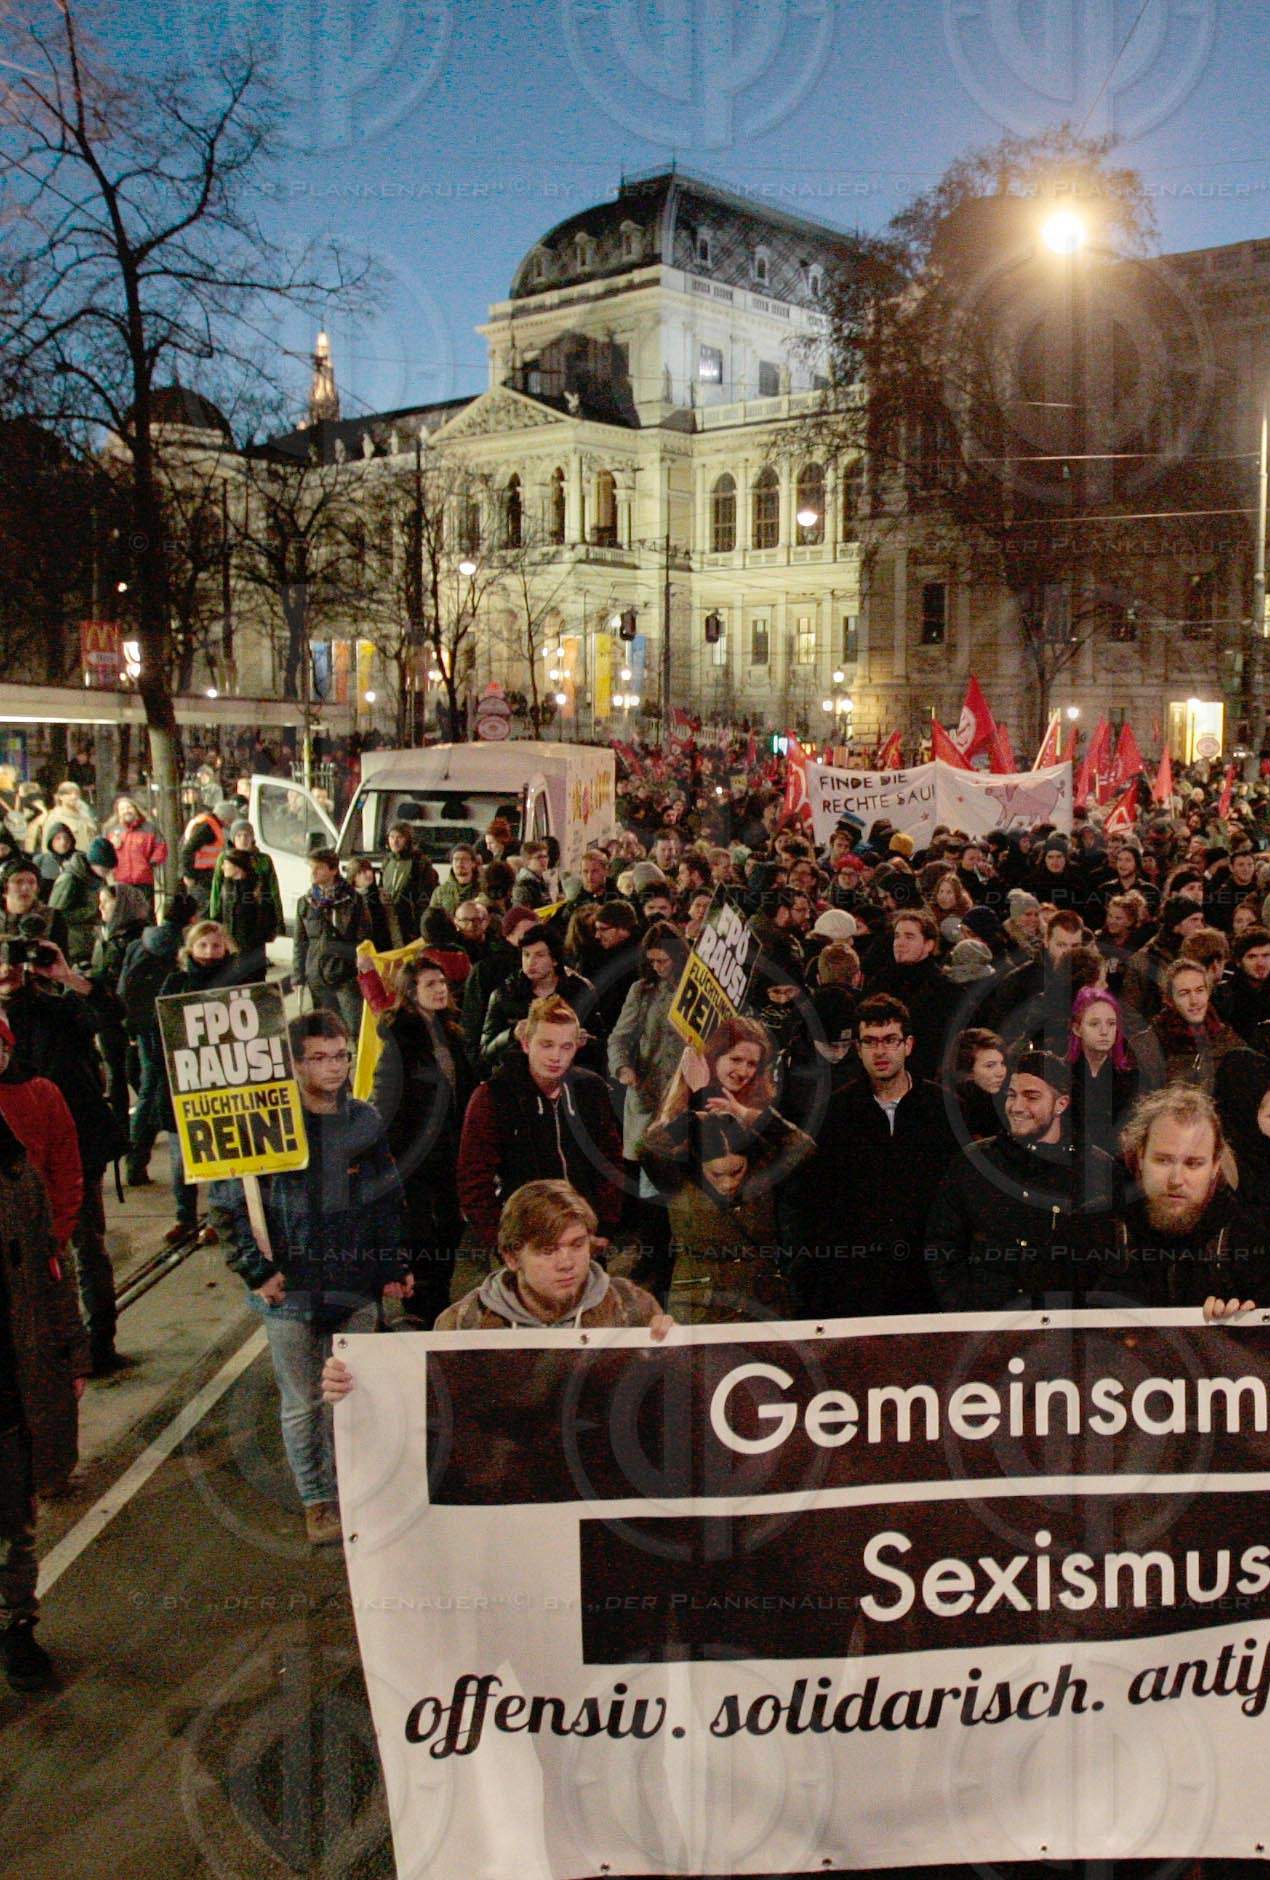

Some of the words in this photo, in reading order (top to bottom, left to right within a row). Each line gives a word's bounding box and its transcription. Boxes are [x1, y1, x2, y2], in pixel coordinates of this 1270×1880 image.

[818, 775, 874, 791] FINDE
[879, 774, 908, 786] DIE
[821, 794, 889, 814] RECHTE
[696, 924, 748, 1007] RAUS!
[182, 989, 260, 1048] FPÖ
[173, 1036, 286, 1092] RAUS!
[182, 1087, 291, 1118] FLÜCHTLINGE
[185, 1106, 299, 1164] REIN!
[710, 1357, 1267, 1455] Gemeinsam
[404, 1673, 687, 1760] offensiv.
[710, 1663, 1105, 1738] solidarisch.
